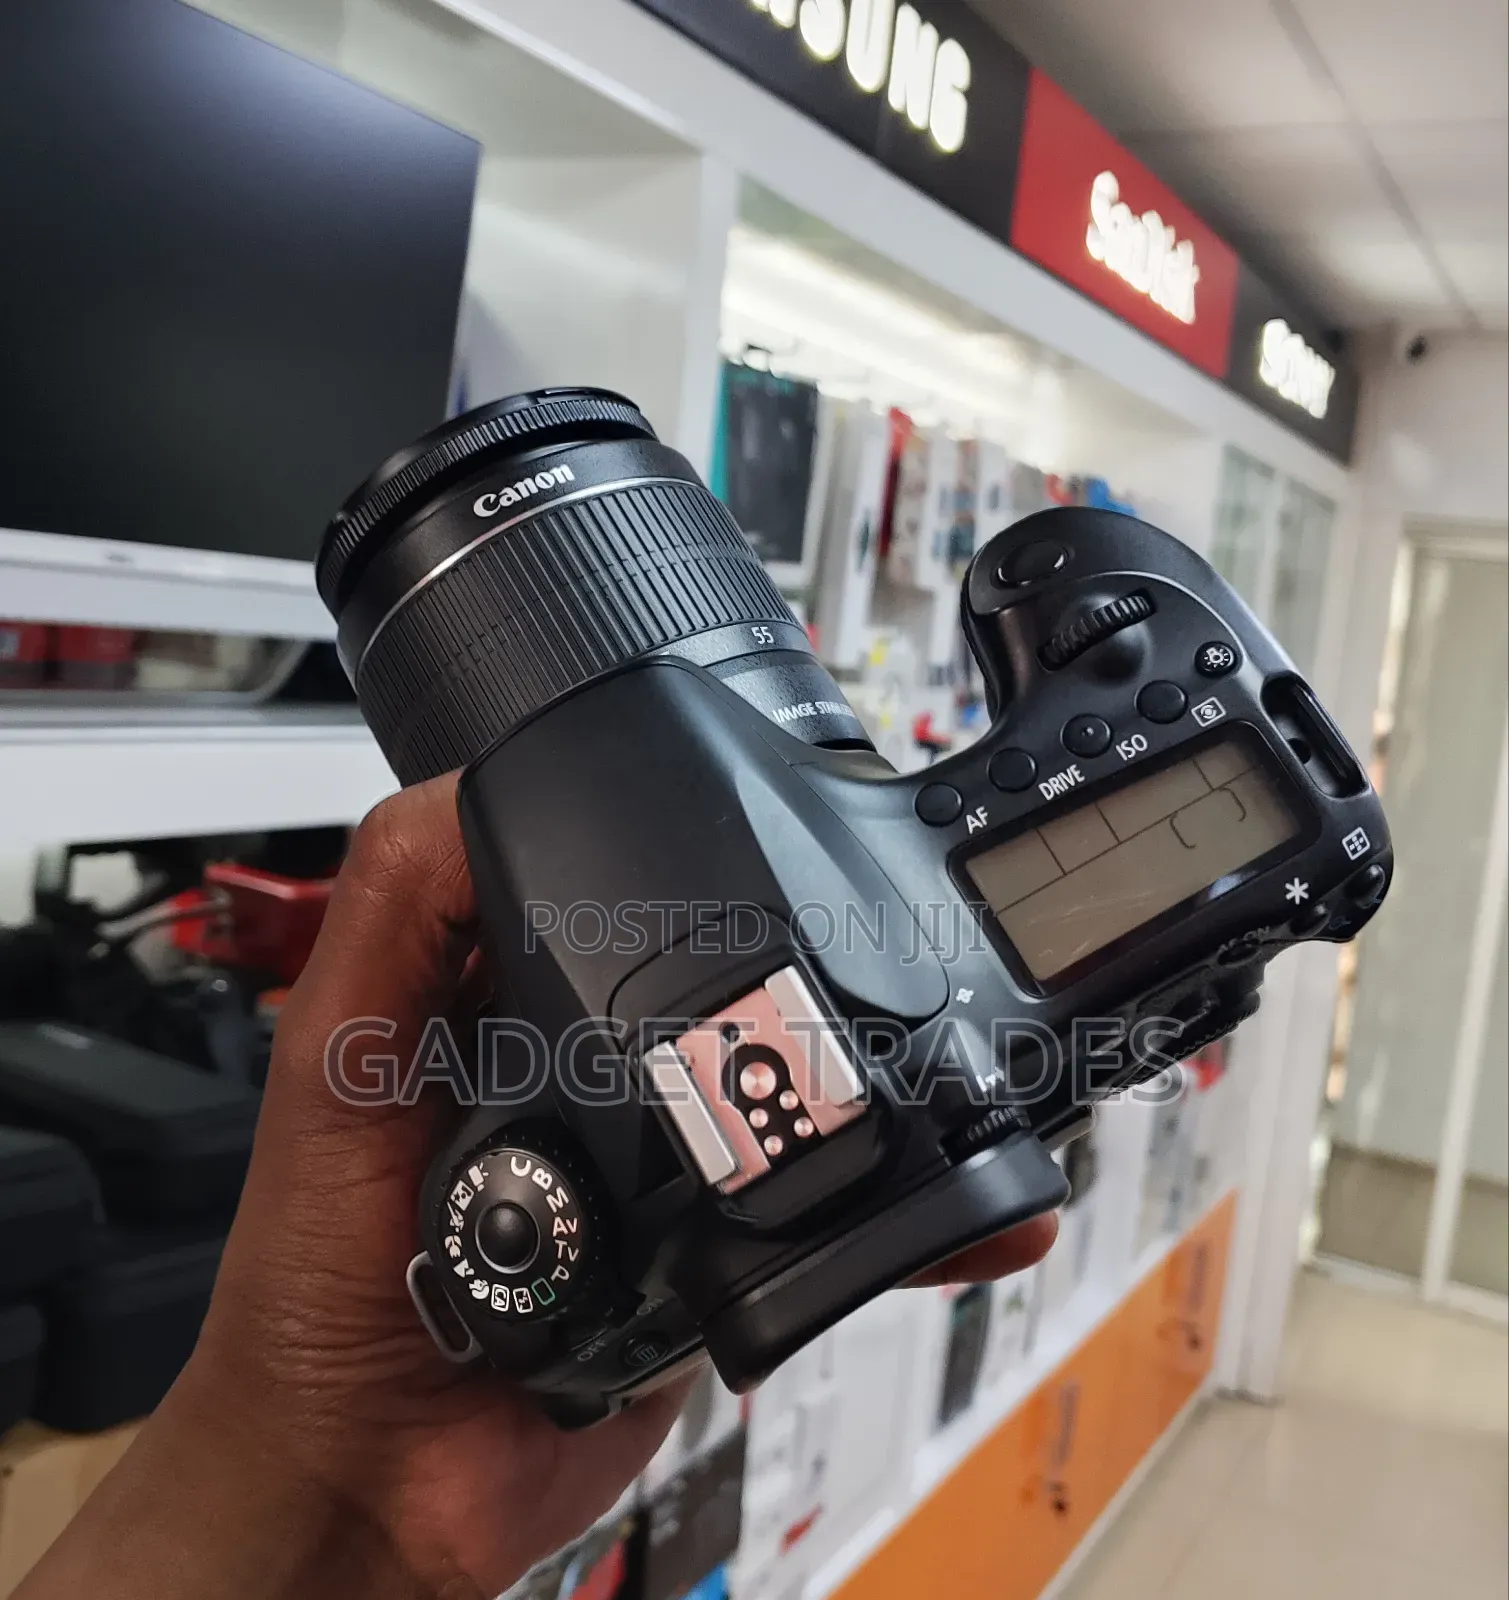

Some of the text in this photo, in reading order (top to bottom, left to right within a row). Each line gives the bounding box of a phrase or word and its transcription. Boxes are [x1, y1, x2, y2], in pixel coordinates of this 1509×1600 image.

[747, 0, 971, 153] SUNG
[473, 464, 575, 518] Canon
[751, 626, 774, 645] 55
[772, 702, 817, 723] IMAGE
[1115, 734, 1148, 761] ISO
[1038, 764, 1086, 800] DRIVE
[965, 806, 989, 834] AF
[510, 1156, 531, 1177] C
[531, 1167, 553, 1190] B
[545, 1186, 569, 1213] M
[550, 1264, 570, 1282] P
